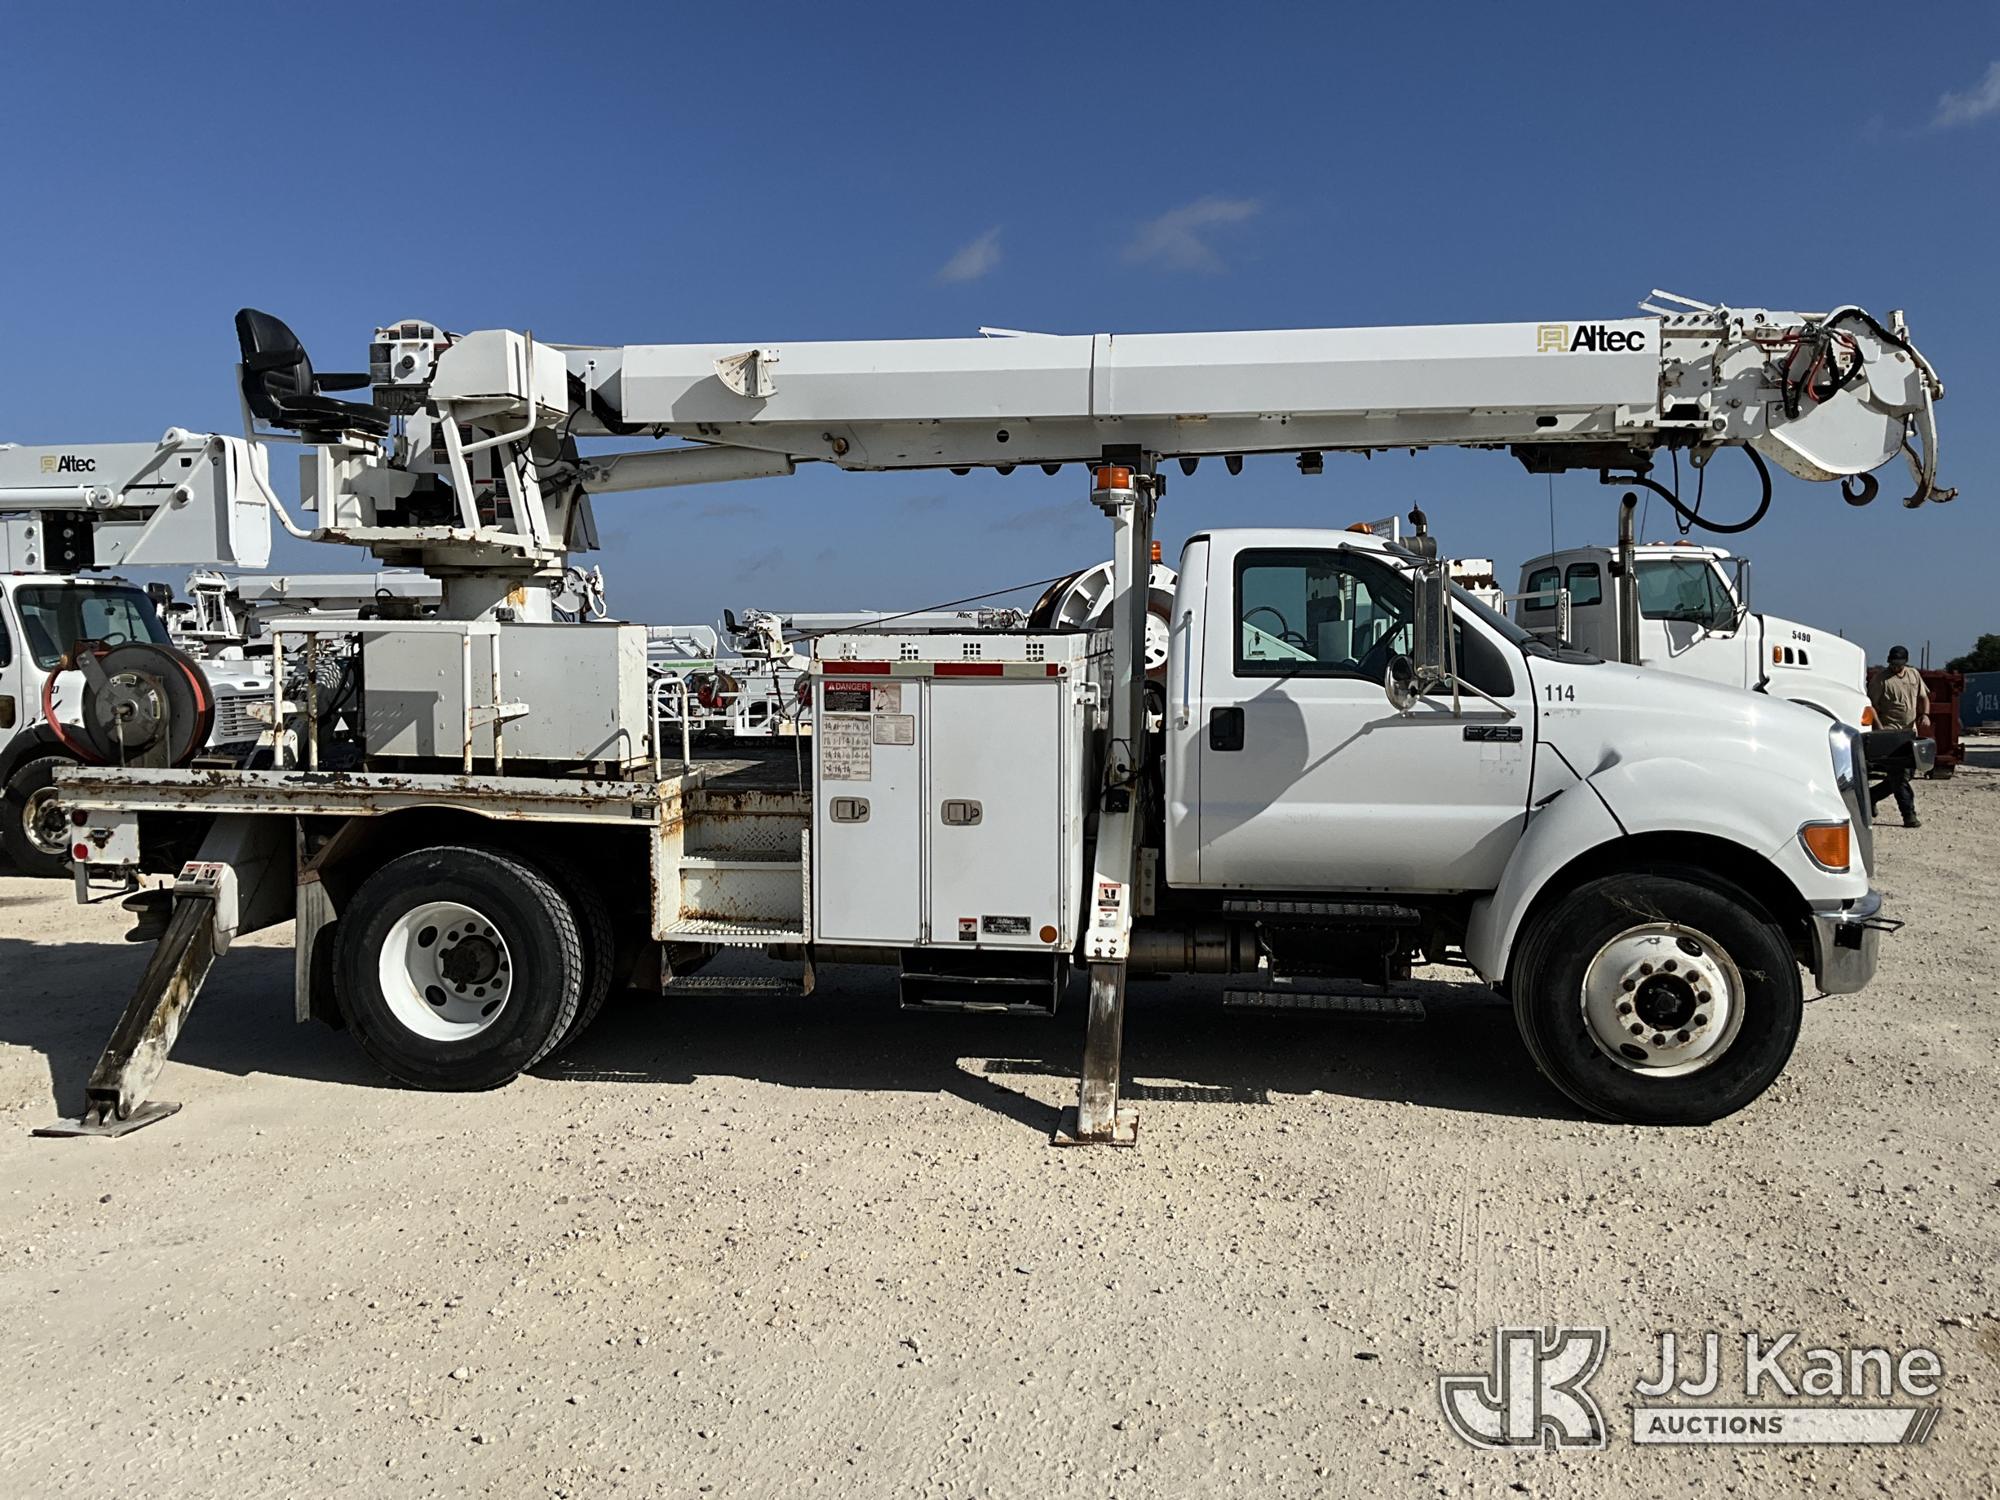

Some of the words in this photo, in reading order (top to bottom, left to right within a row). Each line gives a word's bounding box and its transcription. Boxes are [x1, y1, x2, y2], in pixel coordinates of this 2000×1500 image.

[1569, 325, 1646, 352] Altec
[57, 455, 96, 472] Altec
[835, 682, 868, 691] DANGER
[1545, 684, 1575, 701] 114
